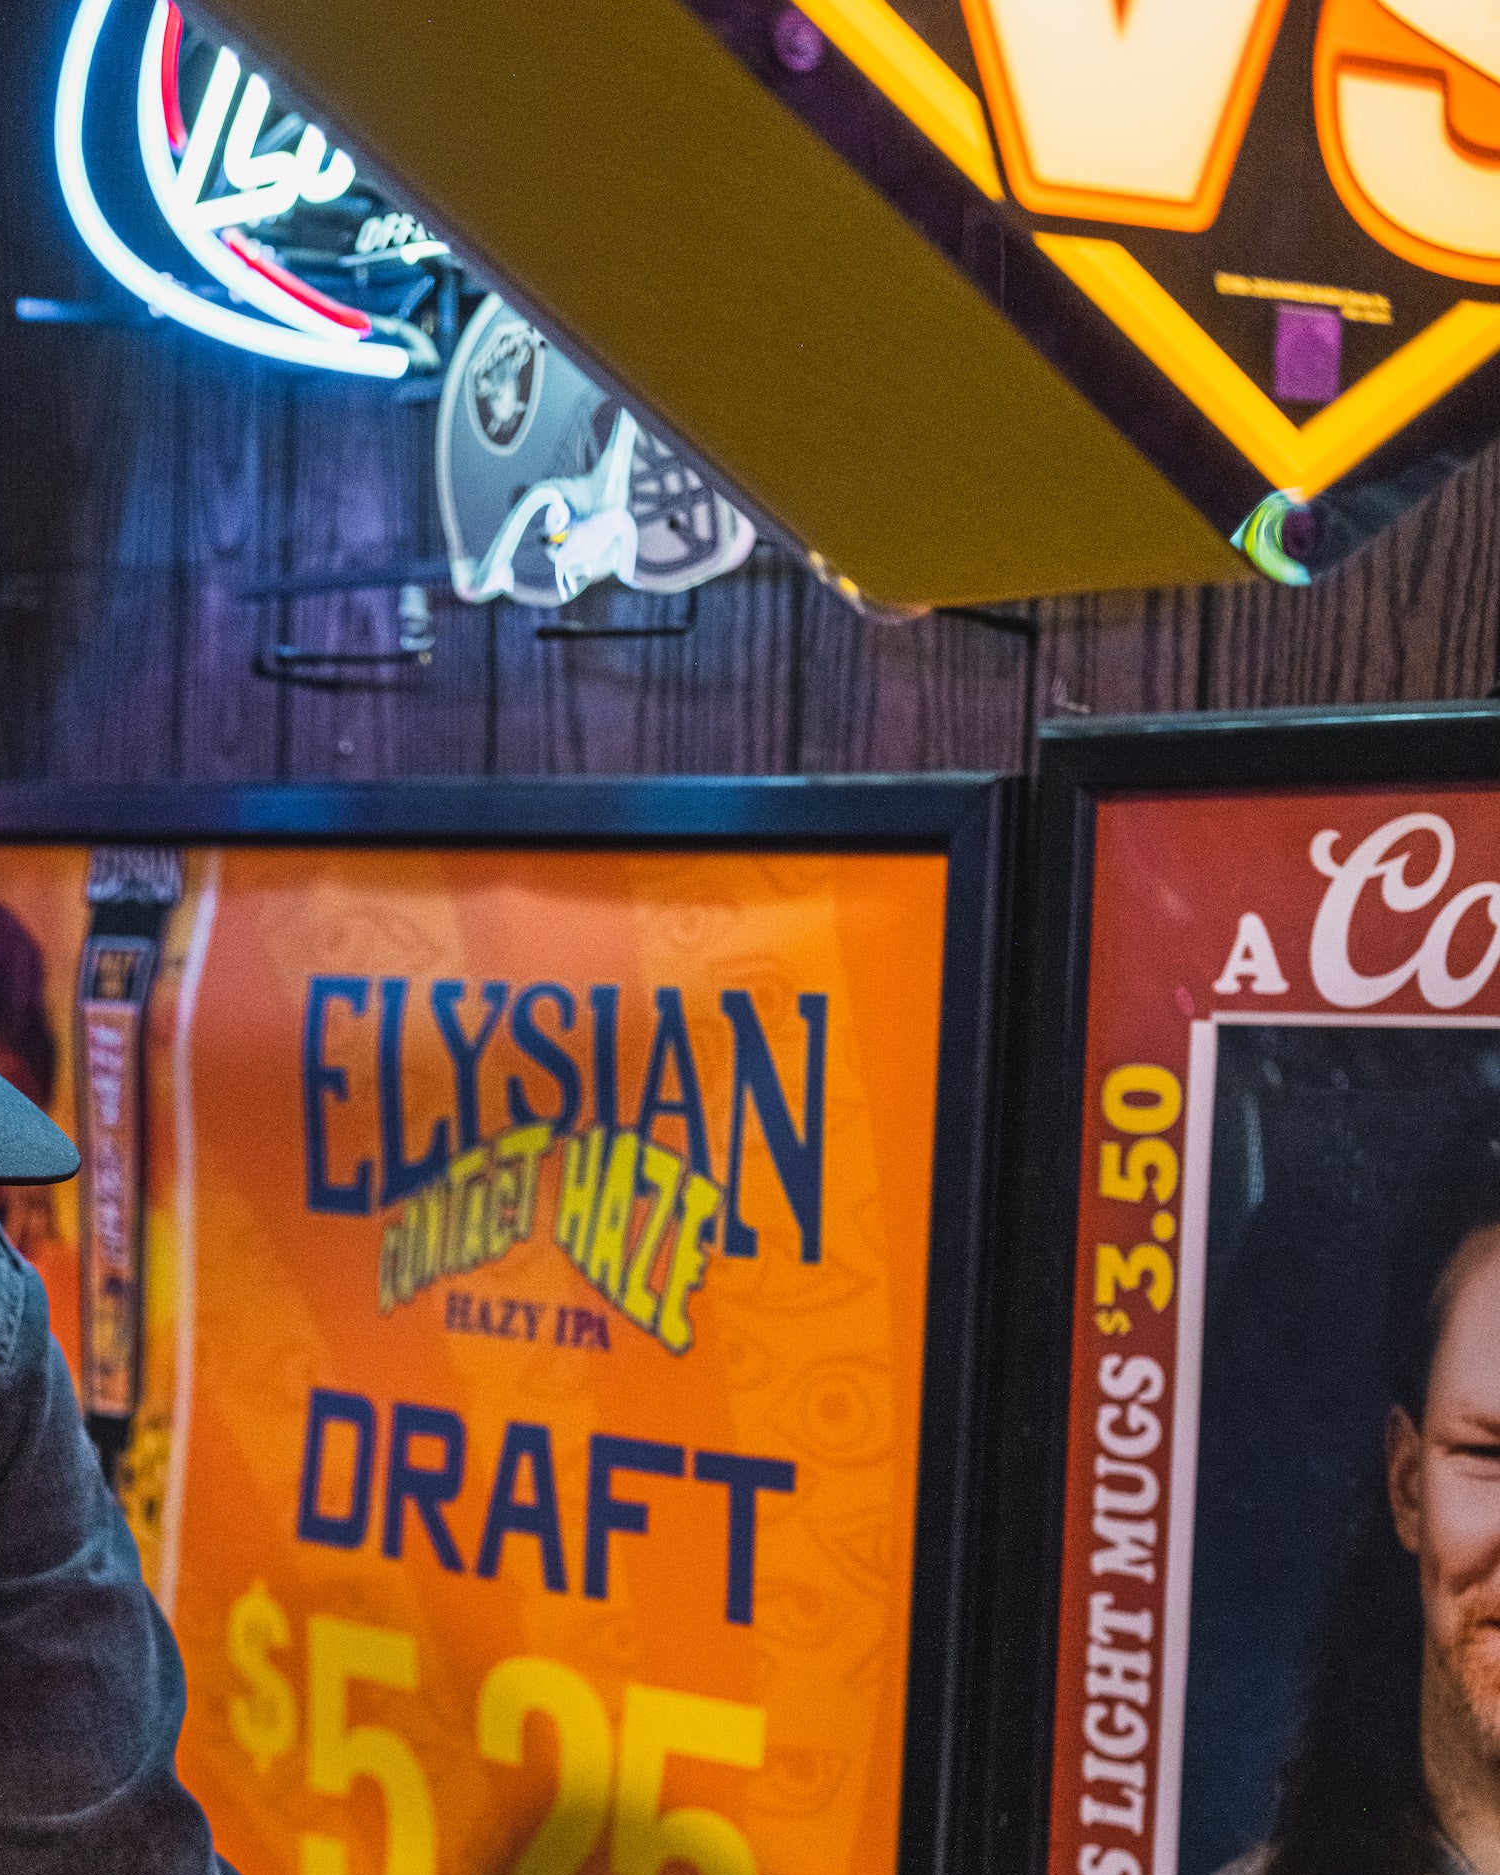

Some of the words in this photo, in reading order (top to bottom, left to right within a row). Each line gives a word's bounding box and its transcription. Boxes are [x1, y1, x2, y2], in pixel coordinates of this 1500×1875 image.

[1212, 911, 1290, 995] A
[303, 972, 831, 1267] ELYSIAN
[1094, 1062, 1183, 1336] $3.50
[443, 1291, 547, 1342] HAZY
[554, 1304, 612, 1352] IPA
[554, 1122, 724, 1358] HAZE
[296, 1386, 797, 1627] DRAFT
[1090, 1352, 1166, 1585] MUGS
[1079, 1590, 1154, 1836] LIGHT
